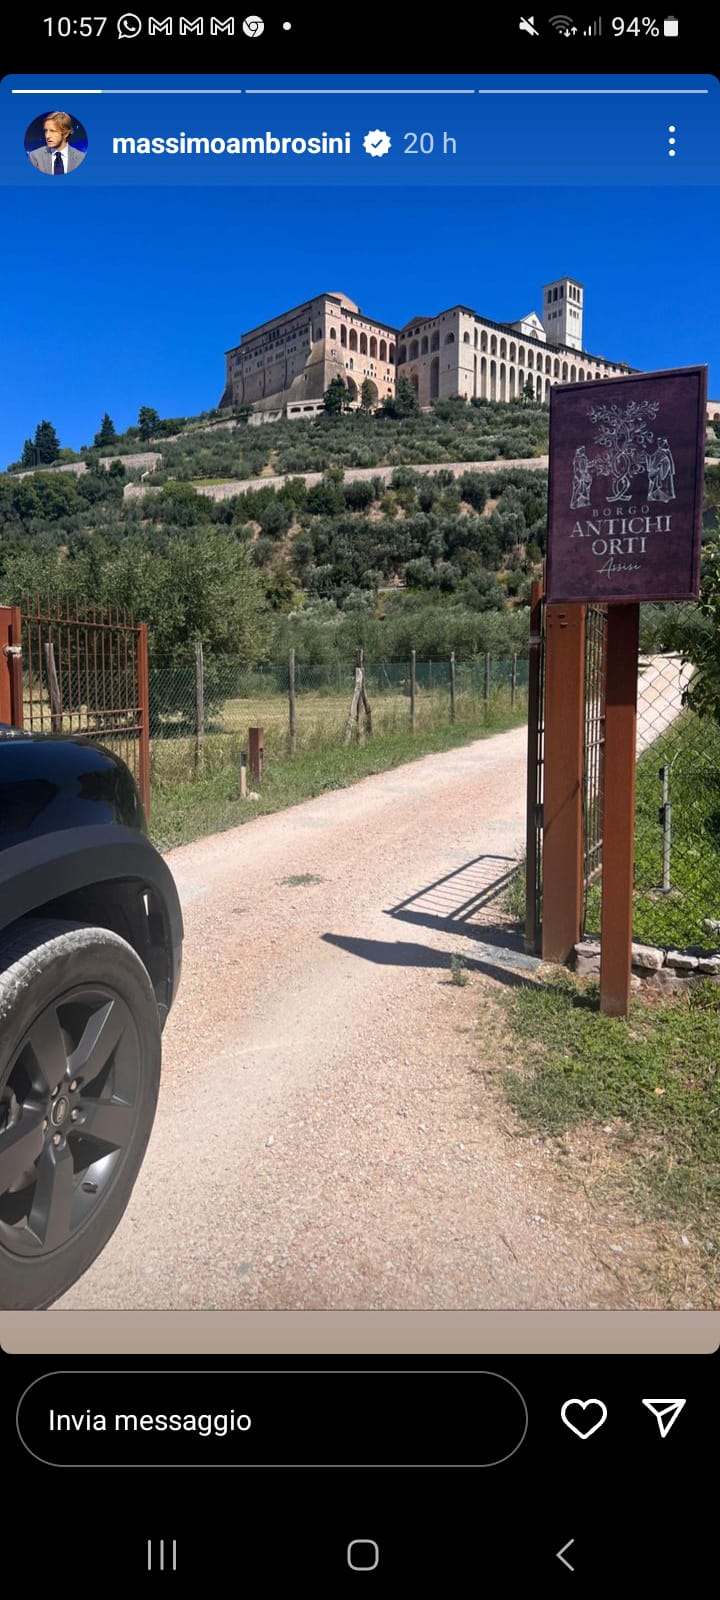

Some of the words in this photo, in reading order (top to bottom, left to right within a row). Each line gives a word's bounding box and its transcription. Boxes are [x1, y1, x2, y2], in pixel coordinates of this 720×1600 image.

[592, 504, 650, 517] BORGO
[570, 515, 672, 538] ANTICHI
[591, 537, 648, 556] ORTI
[595, 557, 642, 579] Assisi
